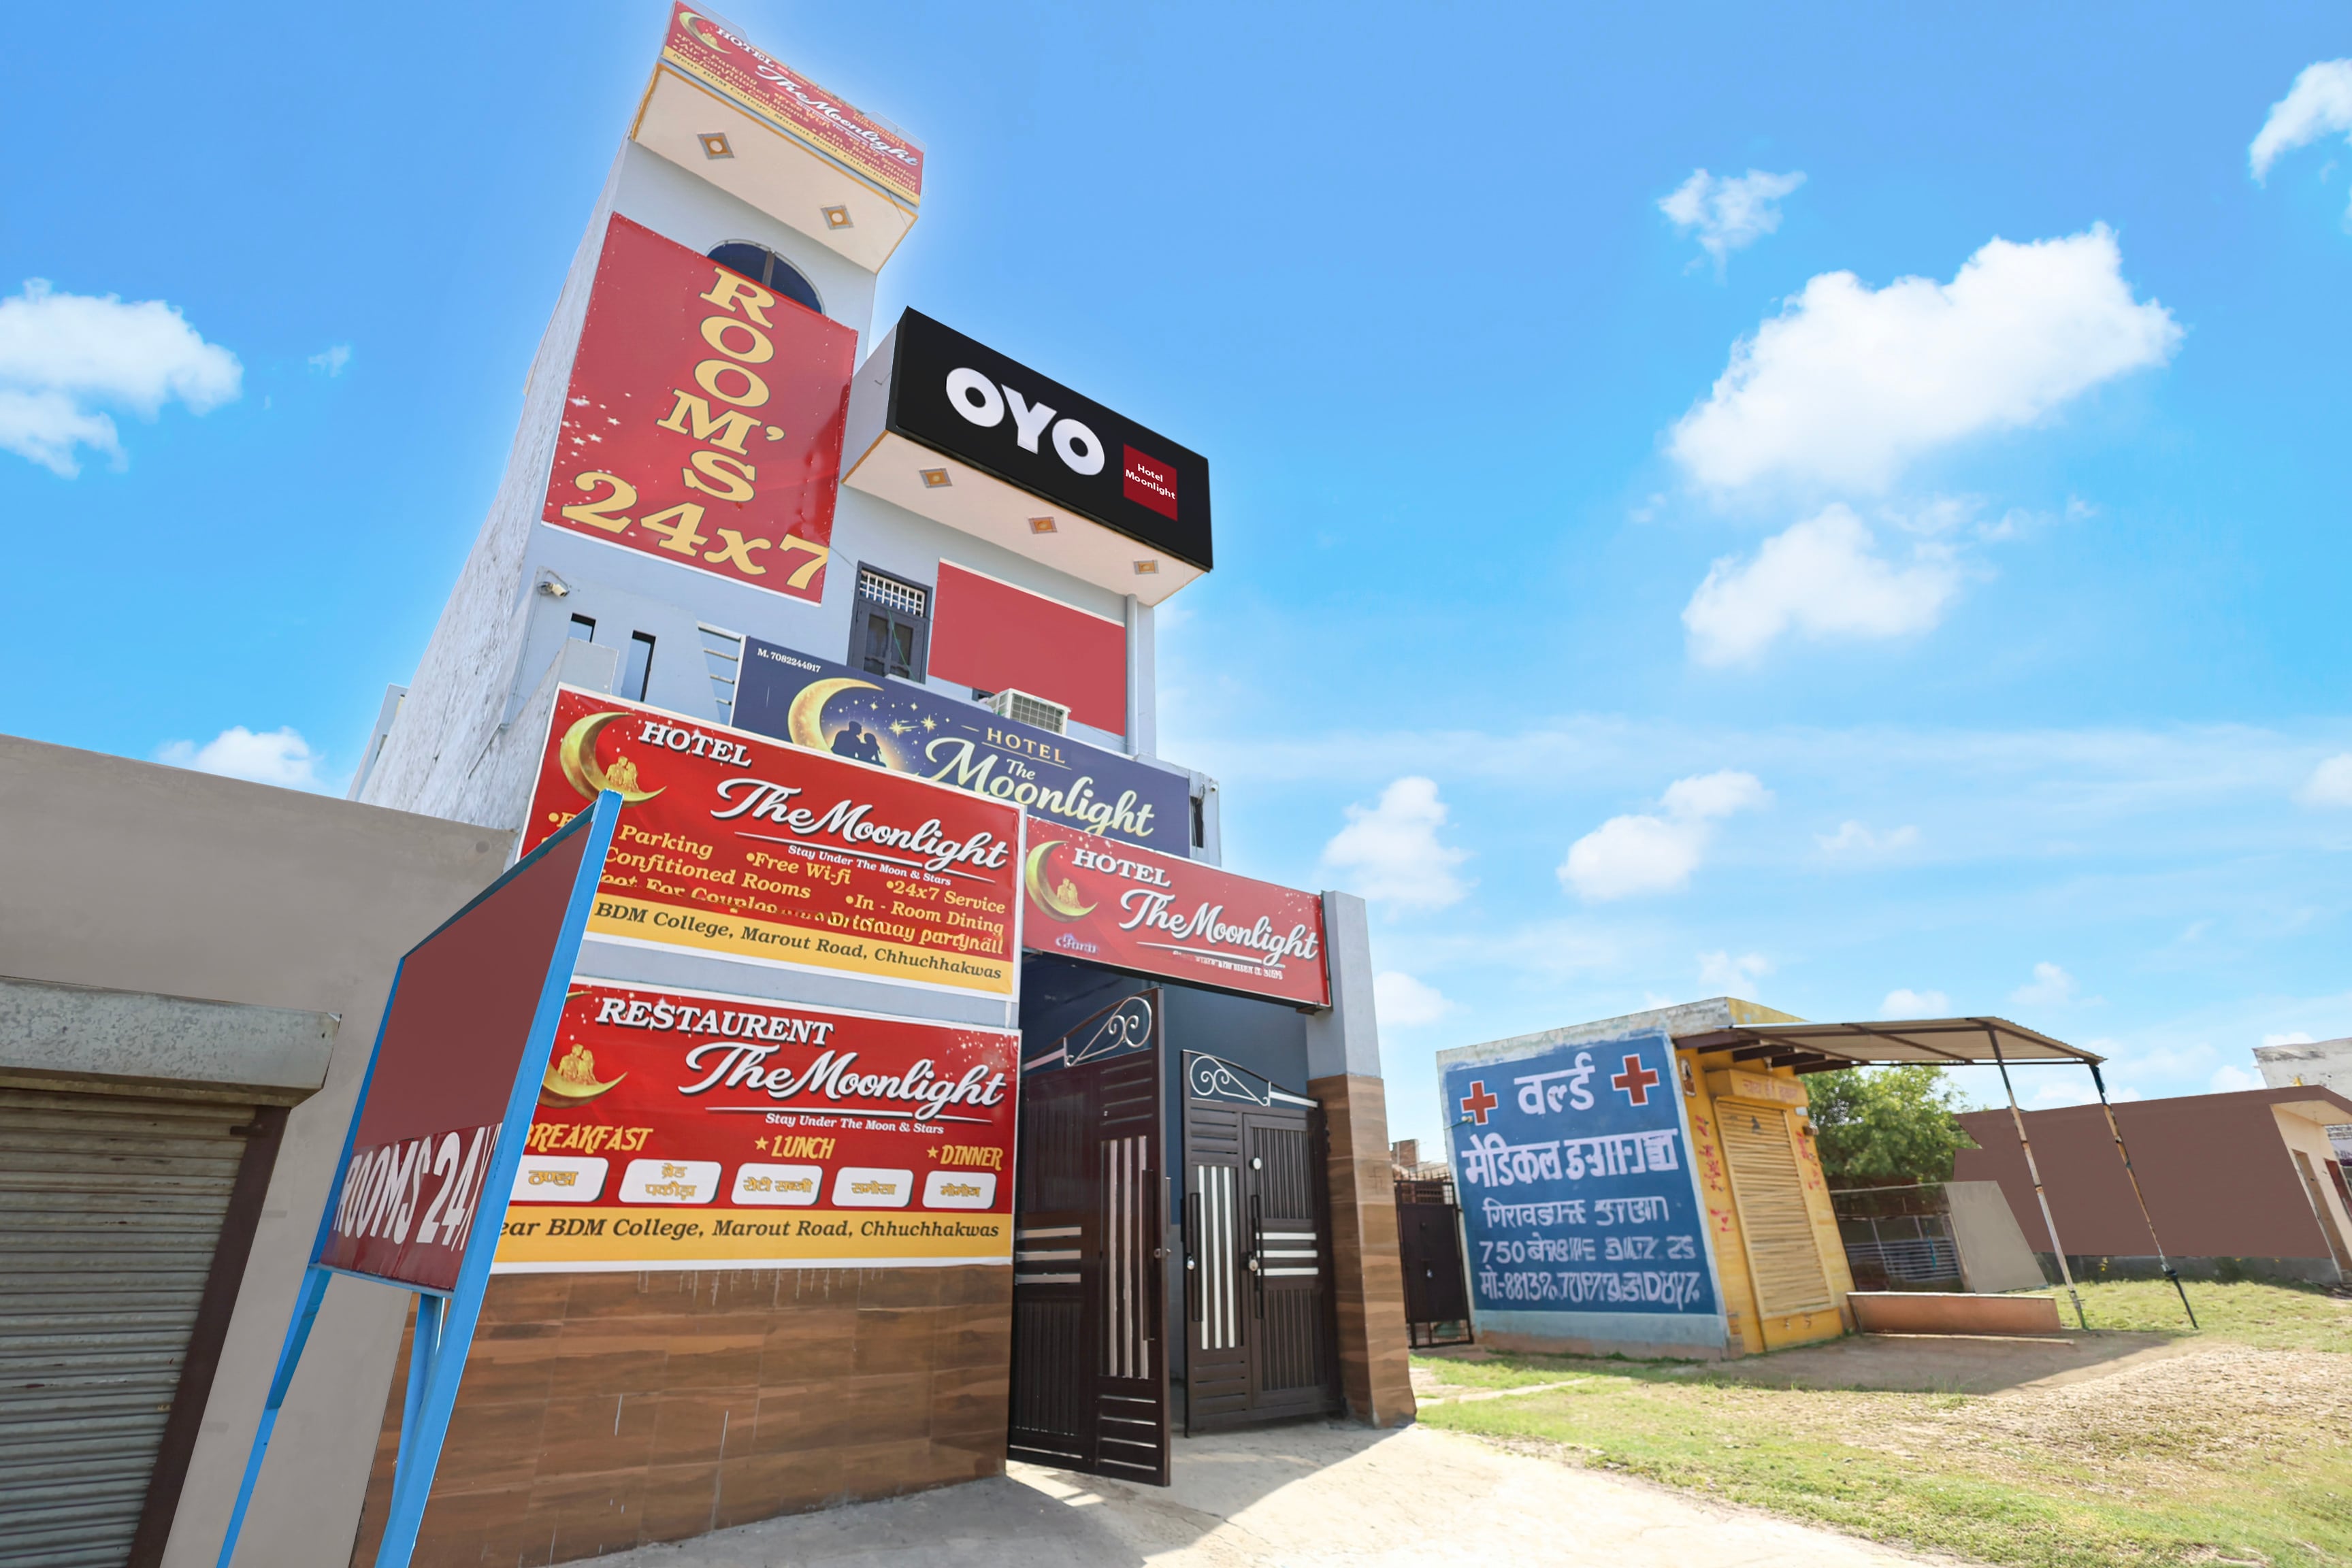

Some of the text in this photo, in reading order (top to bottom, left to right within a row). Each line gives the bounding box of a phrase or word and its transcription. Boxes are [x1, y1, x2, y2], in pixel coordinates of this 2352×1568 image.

[681, 37, 757, 83] Free Parking
[716, 28, 774, 67] HOTEL
[672, 54, 698, 69] Near
[703, 71, 727, 85] BDM
[678, 49, 721, 74] Perfect
[725, 77, 745, 88] For
[747, 91, 791, 117] Couples
[679, 42, 700, 54] Air
[772, 99, 809, 120] Rooms
[754, 65, 810, 103] The
[802, 100, 919, 166] Moonlight
[778, 95, 802, 110] Free
[852, 146, 879, 163] Room
[883, 165, 915, 185] Dining
[881, 158, 917, 180] Service
[946, 368, 1105, 476] OYO
[1125, 470, 1176, 500] Moonlight
[1137, 463, 1164, 483] Hotel
[561, 470, 828, 590] 24x7
[757, 647, 821, 672] M. 7082244917
[638, 721, 752, 766] HOTEL
[986, 726, 1066, 764] HOTEL
[922, 736, 1155, 837] Moonlight
[1006, 757, 1036, 781] The
[618, 824, 713, 860] Parking
[710, 778, 1009, 872] The Moonlight
[742, 869, 811, 899] Rooms
[753, 852, 851, 885] Free Wi-fi
[788, 845, 951, 885] Stay Under The Moon & Stars
[1071, 847, 1171, 887] HOTEL
[855, 894, 875, 911] In
[891, 900, 941, 923] Room
[947, 914, 1004, 936] Dining
[895, 880, 1005, 914] 24x7 Service
[595, 902, 1002, 979] BDM College, Marout Road, Chhuchhakwas
[1119, 889, 1188, 929] The
[1171, 902, 1318, 966] Moonlight
[595, 996, 834, 1045] RESTAURENT
[678, 1041, 1007, 1121] The Moonlight
[1514, 1052, 1596, 1115] वर्ल्ड
[765, 1113, 945, 1134] Stay Under The Moon & Stars
[771, 1135, 836, 1159] LUNCH
[940, 1144, 1004, 1171] DINNER
[1461, 1132, 1563, 1188] मेडिकल
[333, 1136, 431, 1245] ROOMS
[851, 1180, 896, 1195] समोसा
[501, 1218, 999, 1240] ear BDM College, Marout Road, Chhuchhakwas
